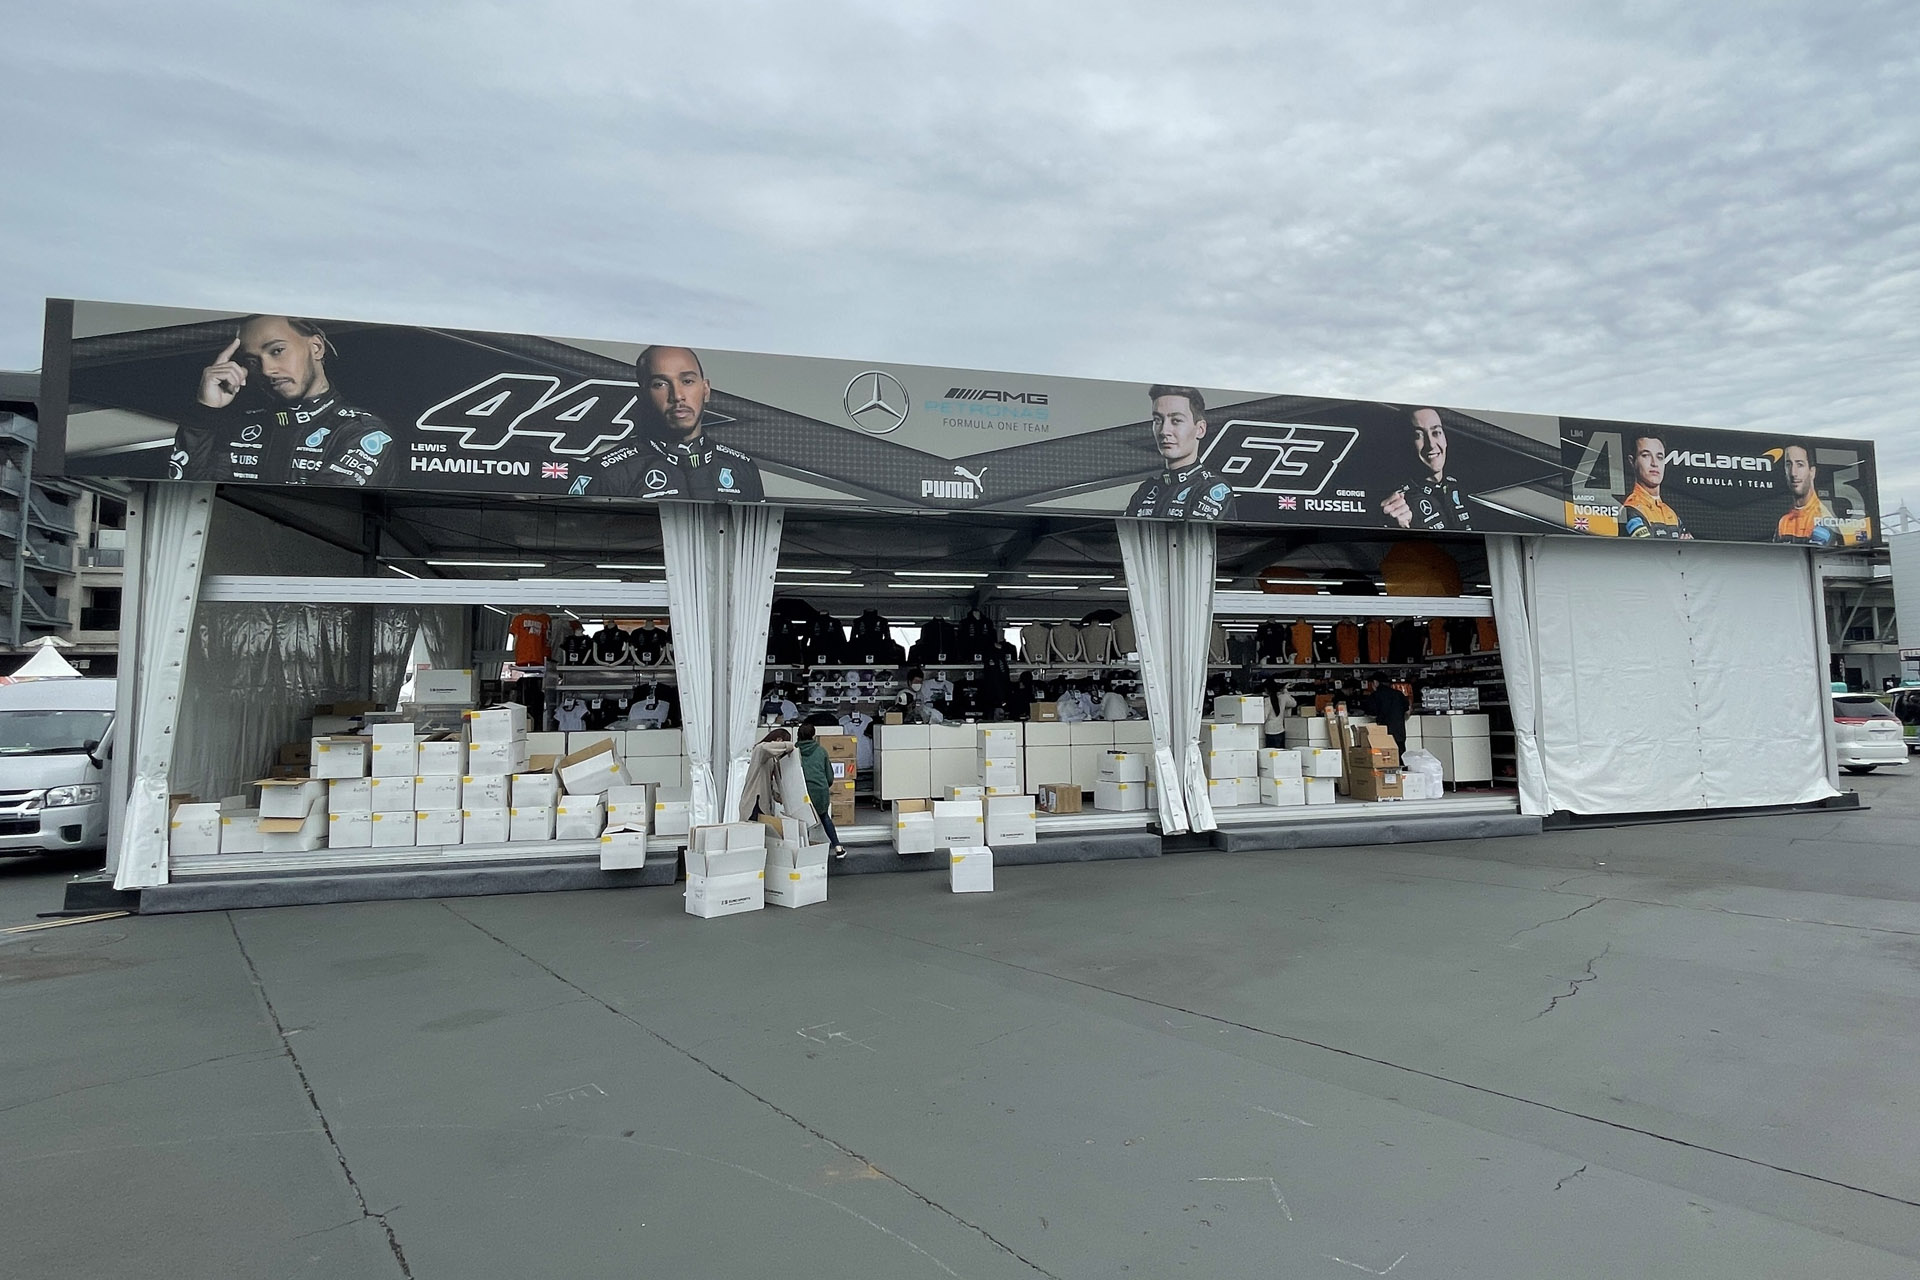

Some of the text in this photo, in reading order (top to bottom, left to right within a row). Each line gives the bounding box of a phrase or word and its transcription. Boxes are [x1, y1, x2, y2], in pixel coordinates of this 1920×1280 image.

[416, 373, 640, 455] 44
[924, 400, 1050, 421] PETRONAS
[942, 418, 1049, 433] FORMULA ONE TEAM
[411, 442, 448, 453] LEWIS
[239, 455, 259, 466] UBS
[410, 456, 530, 476] HAMILTON
[1200, 419, 1360, 496] 63
[1664, 450, 1772, 472] McLaren
[1572, 431, 1628, 524] 4
[1686, 476, 1733, 487] FORMULA
[1747, 480, 1774, 489] TEAM
[921, 480, 974, 499] PUMA
[1336, 489, 1365, 497] GEORGE
[1304, 499, 1366, 513] RUSSELL
[1574, 504, 1619, 517] NORRIS
